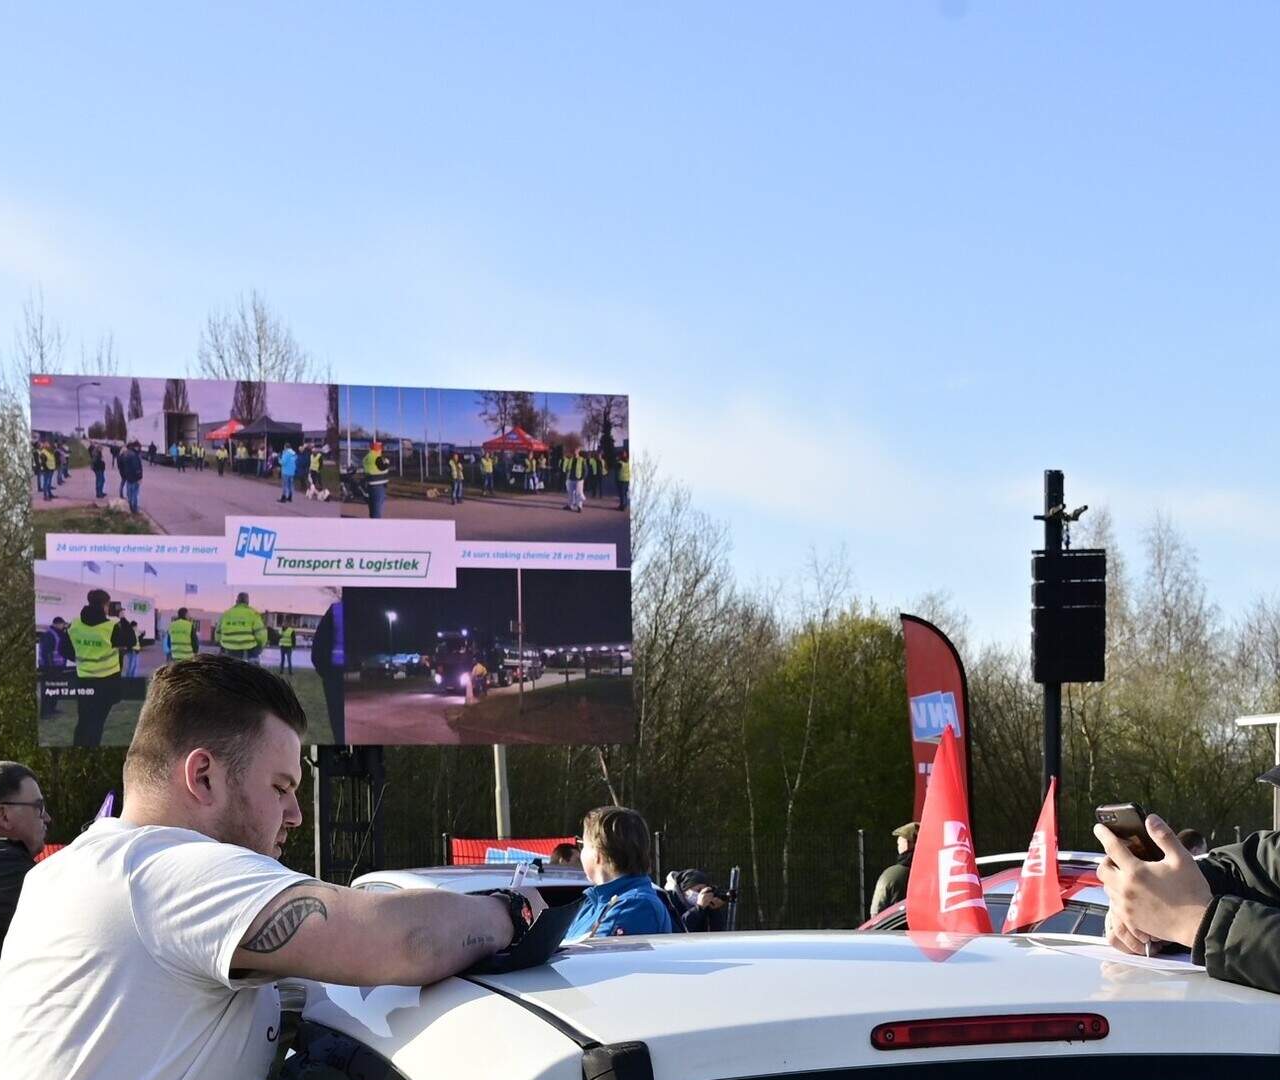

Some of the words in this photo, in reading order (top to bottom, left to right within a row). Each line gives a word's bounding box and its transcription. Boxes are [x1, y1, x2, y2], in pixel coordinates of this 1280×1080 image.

[237, 530, 276, 553] FNV
[276, 556, 342, 571] Transport
[345, 558, 355, 569] &
[358, 558, 420, 572] Logistiek
[45, 688, 60, 697] April
